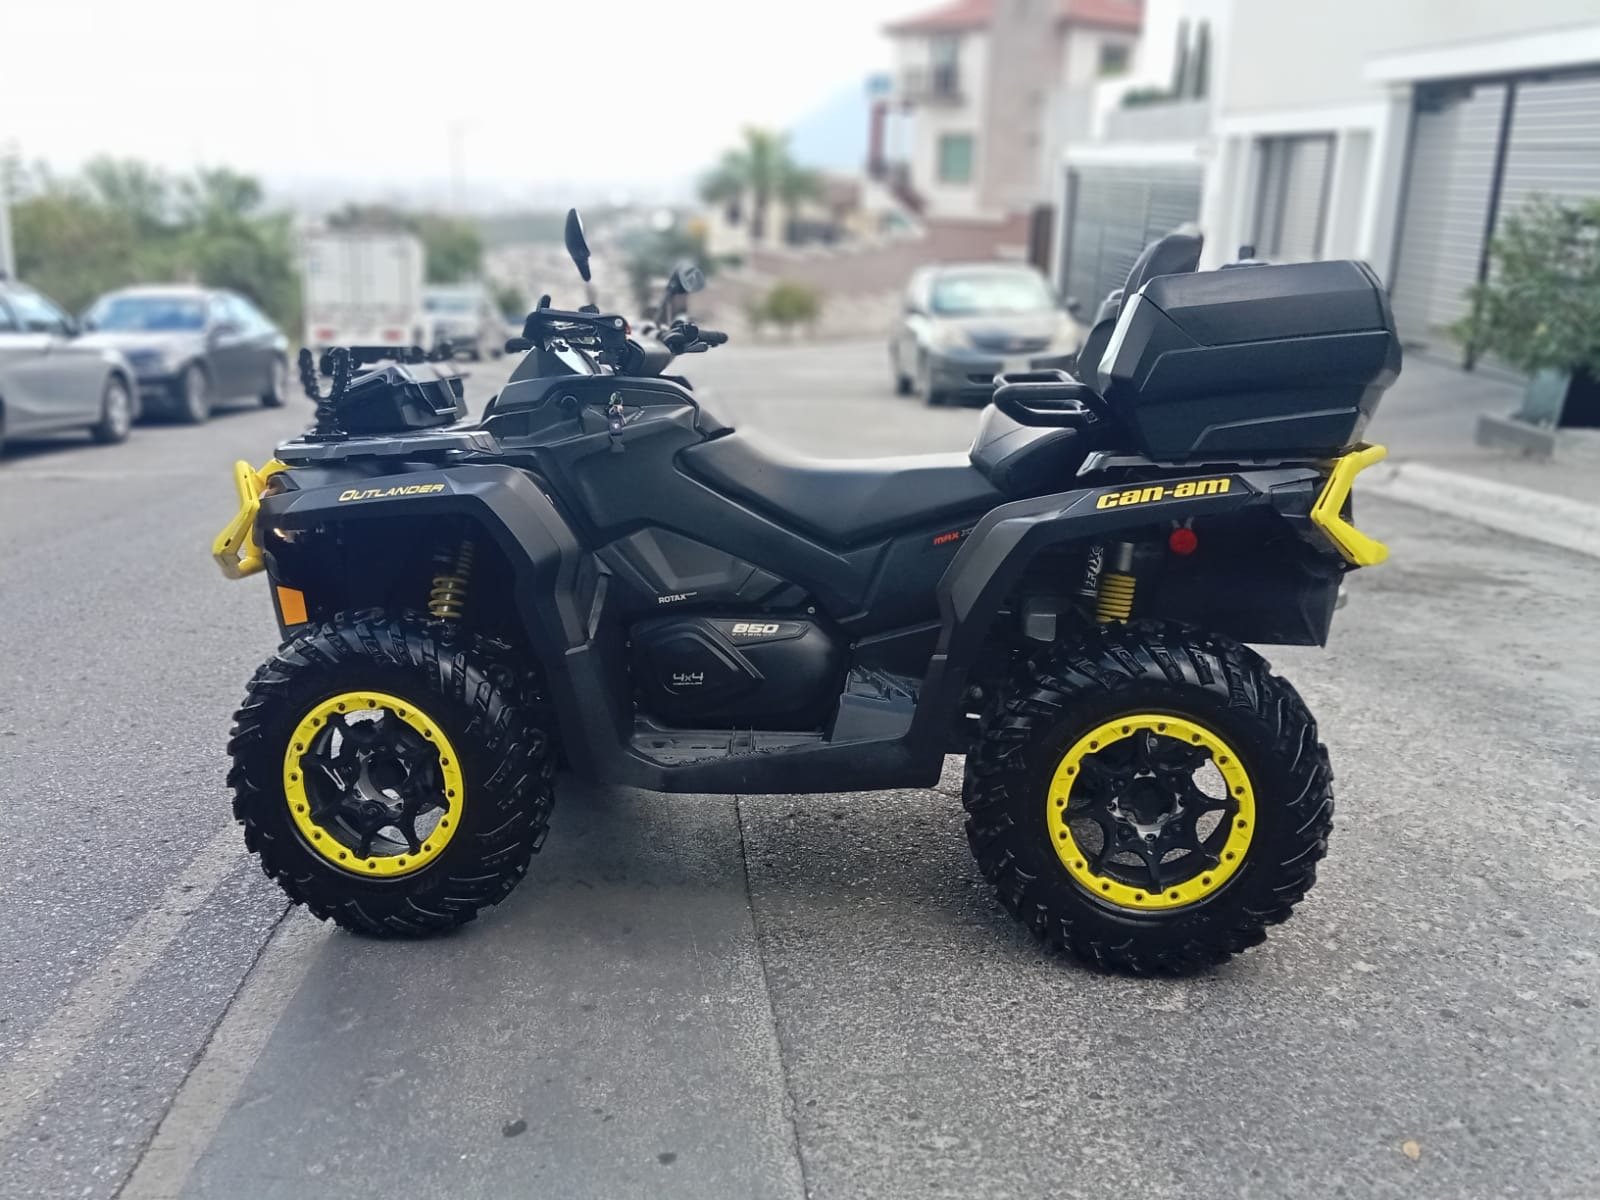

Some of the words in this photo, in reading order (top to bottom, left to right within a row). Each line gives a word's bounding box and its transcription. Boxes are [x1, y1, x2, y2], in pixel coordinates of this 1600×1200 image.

[1096, 478, 1231, 510] can-am
[658, 594, 687, 604] ROTAX
[732, 623, 780, 634] 850
[673, 671, 704, 682] 4x4
